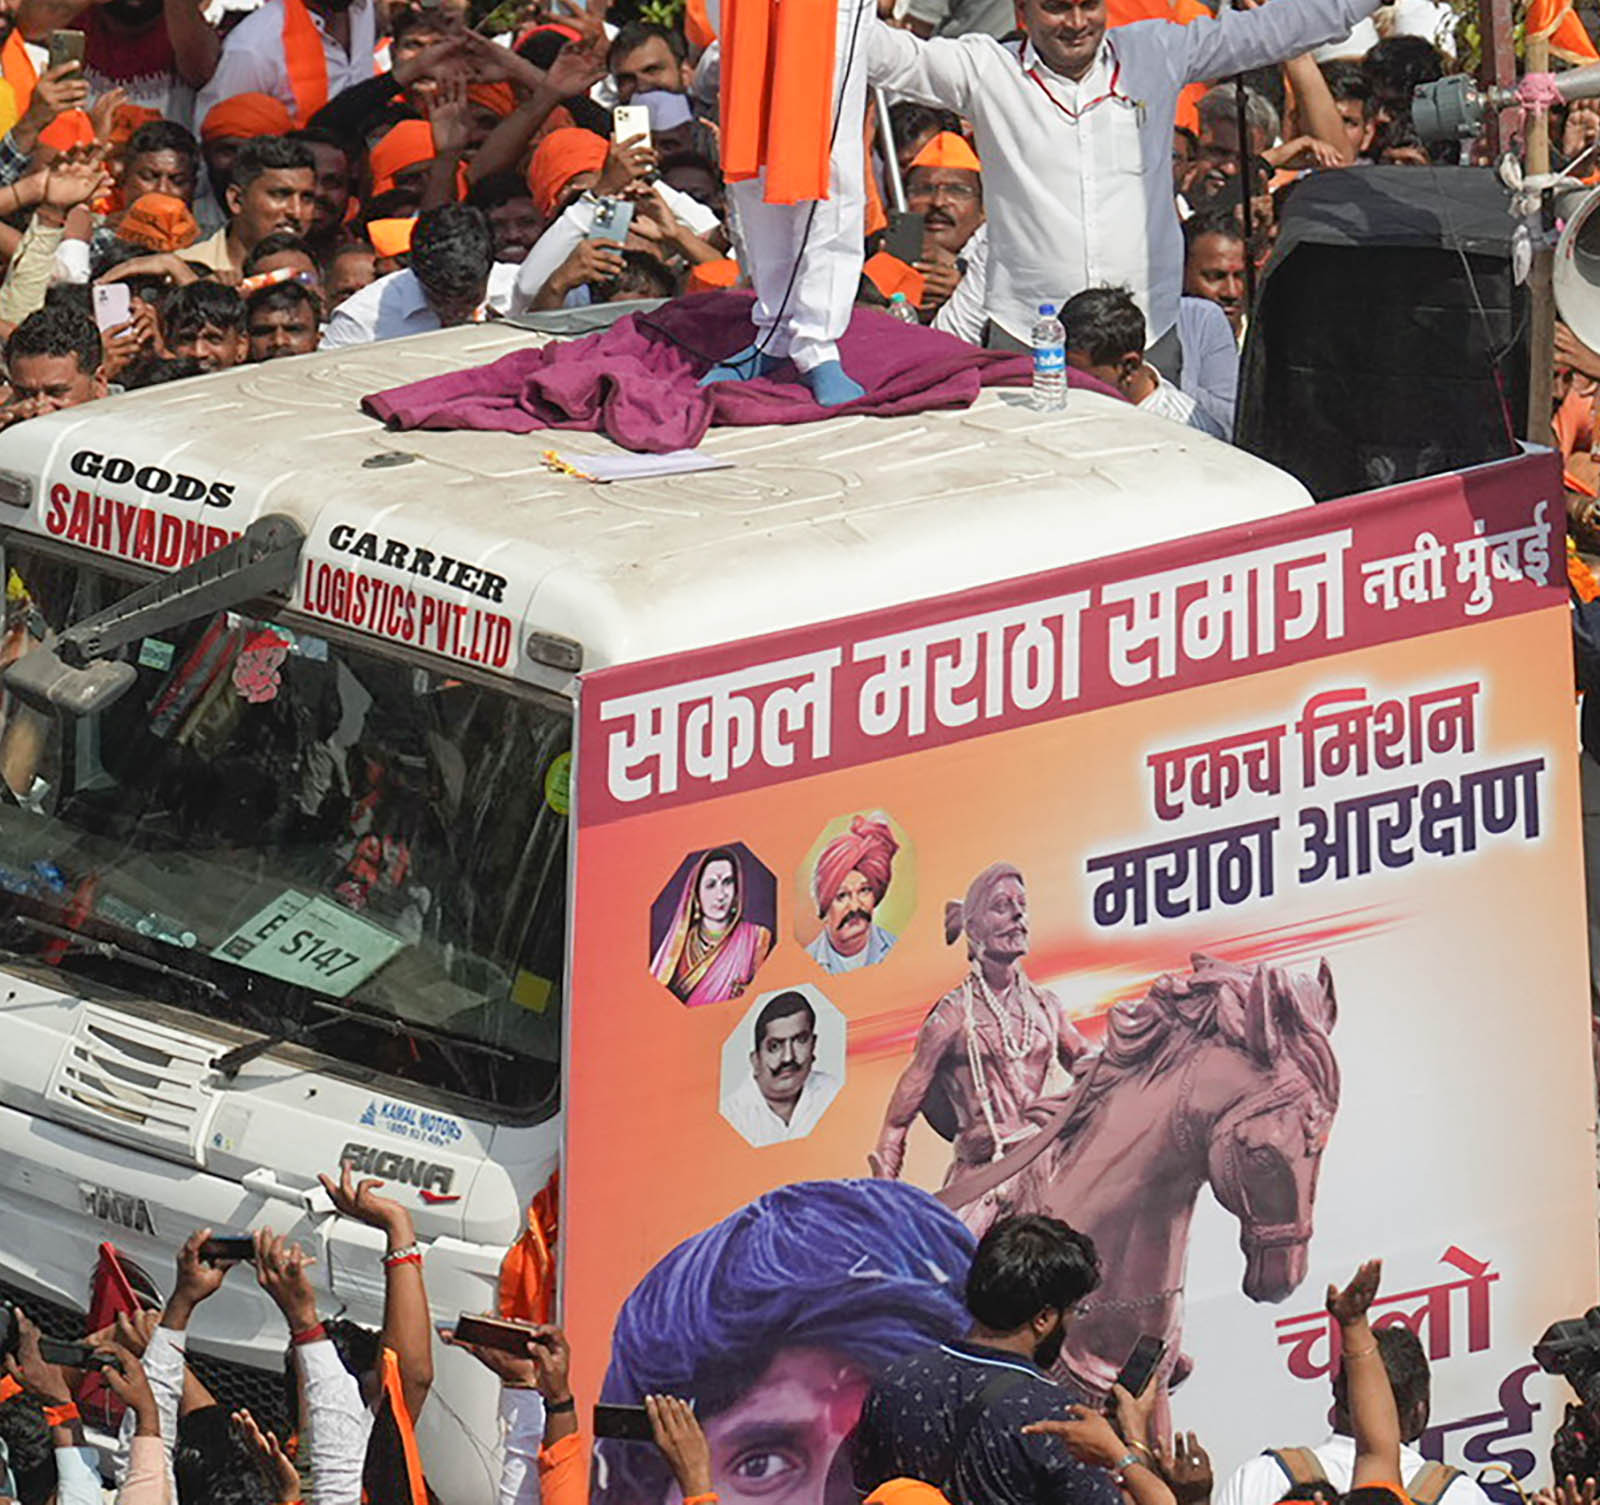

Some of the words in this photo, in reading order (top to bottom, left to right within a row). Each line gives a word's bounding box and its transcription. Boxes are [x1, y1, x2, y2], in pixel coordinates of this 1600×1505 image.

[70, 449, 236, 509] GOODS
[327, 523, 509, 604] CARRIER
[303, 558, 417, 648] LOGISTICS
[599, 647, 843, 804] सकल
[852, 590, 1093, 740] मराठा
[1099, 528, 1355, 689] समाज
[1361, 532, 1449, 612] नवी
[1453, 499, 1554, 617] मुंबई
[1147, 724, 1288, 823] एकच
[1294, 680, 1481, 789] मिशन
[1086, 816, 1281, 928] मराठा
[1296, 756, 1547, 886] आरक्षण
[278, 929, 360, 978] S147
[338, 1141, 456, 1195] SIGNA
[380, 1102, 417, 1127] KAMAL
[419, 1111, 464, 1142] MOTORS
